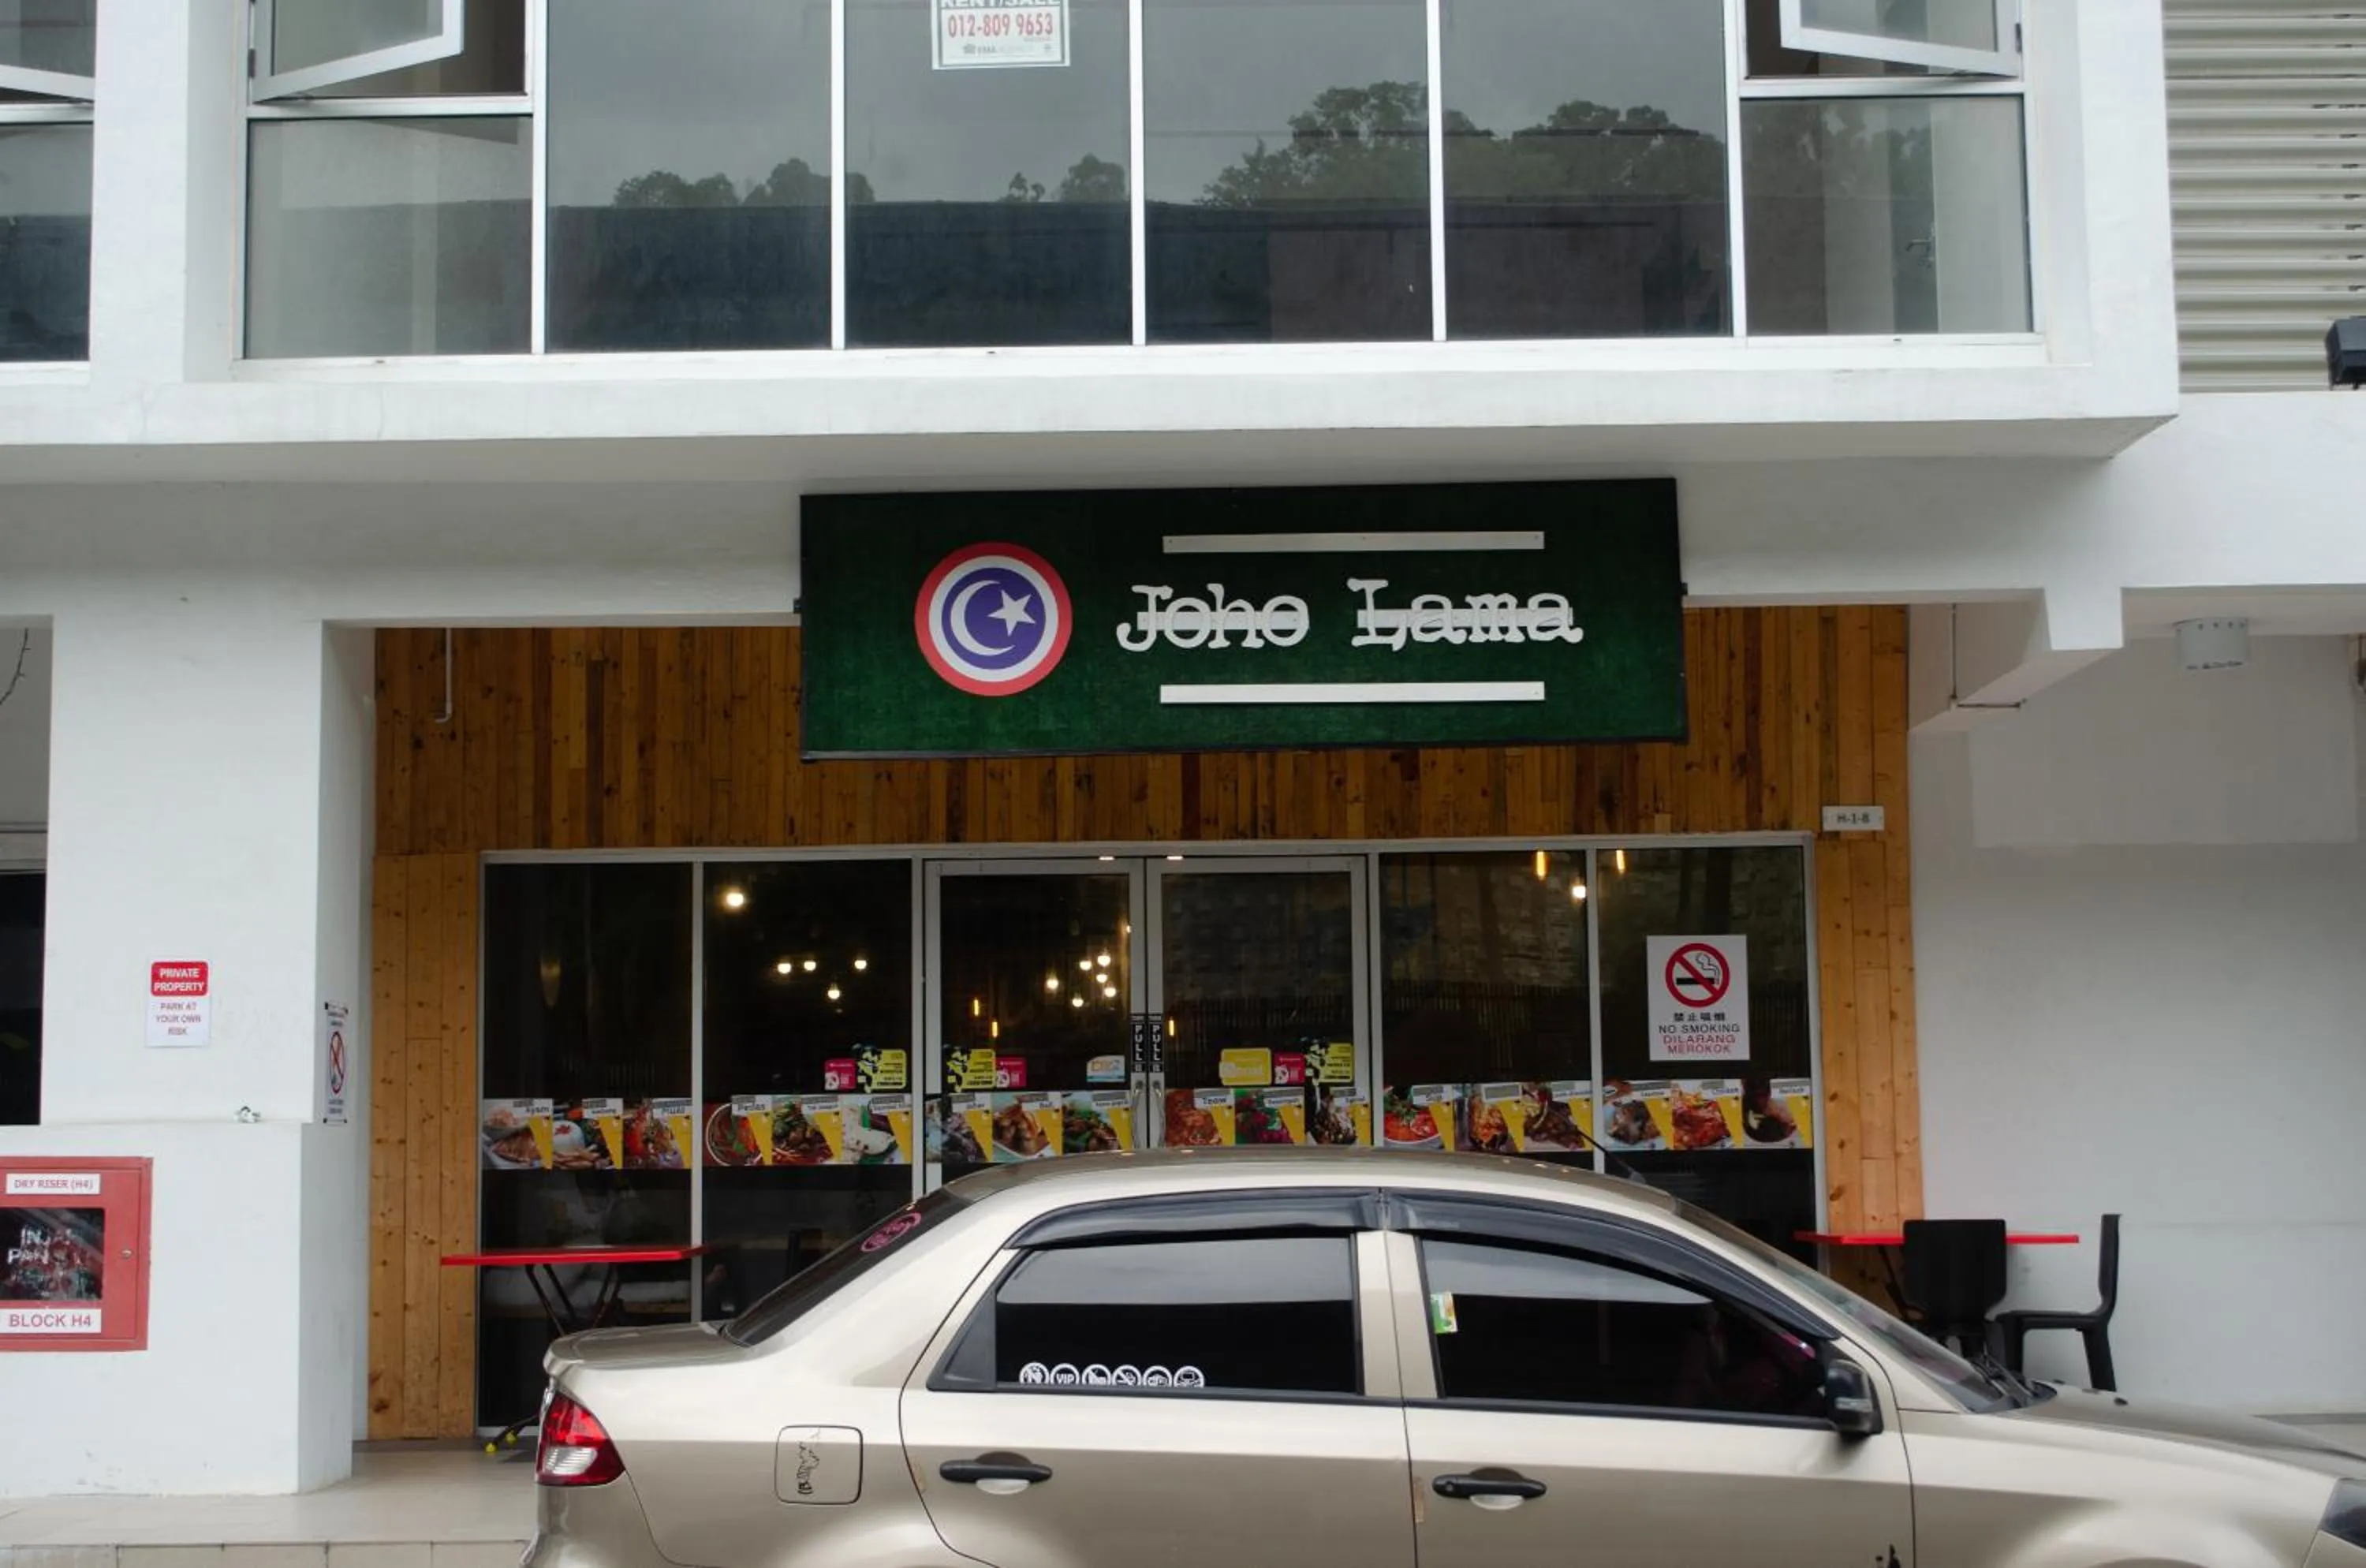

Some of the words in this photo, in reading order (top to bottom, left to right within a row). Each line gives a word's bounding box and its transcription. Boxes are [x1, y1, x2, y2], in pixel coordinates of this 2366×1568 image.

[948, 13, 1010, 38] 012-809
[1016, 12, 1053, 36] 9653
[1116, 583, 1310, 651] Joho
[1347, 578, 1584, 651] Lama
[160, 968, 200, 978] PRIVATE
[154, 981, 204, 991] PROPERTY
[185, 1002, 196, 1010] AT
[156, 1014, 179, 1023] YOUR
[181, 1014, 201, 1023] OWN
[1659, 1025, 1677, 1034] NO
[1681, 1023, 1740, 1034] SMOKING
[1134, 1025, 1143, 1061] PULL
[1152, 1025, 1161, 1061] PULL
[1663, 1034, 1736, 1045] DILARANG
[1667, 1043, 1732, 1055] MEROKOK
[14, 1179, 35, 1189] DRY
[38, 1179, 69, 1189] RISER
[9, 1314, 67, 1327] BLOCK
[72, 1314, 91, 1327] H4
[1056, 1373, 1074, 1383] VIP
